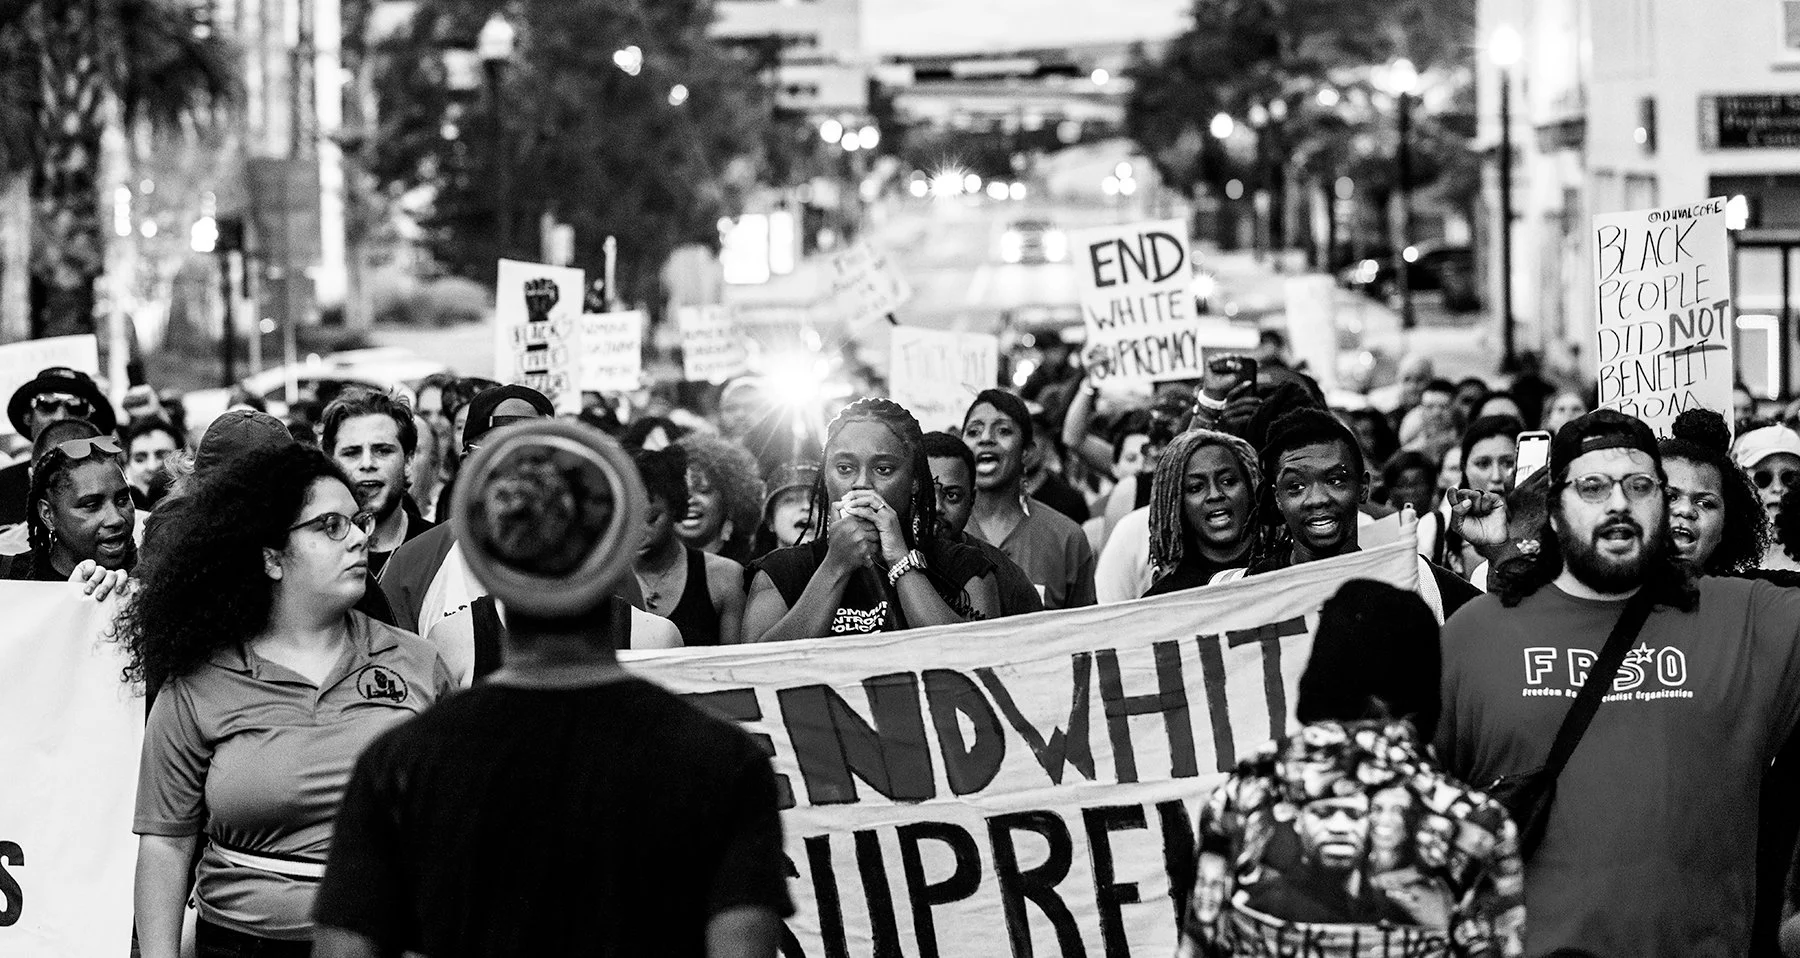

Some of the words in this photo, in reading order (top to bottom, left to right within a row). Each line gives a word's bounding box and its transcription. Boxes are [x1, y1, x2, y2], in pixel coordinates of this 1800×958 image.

[1089, 231, 1184, 288] END
[1597, 219, 1698, 281] BLACK
[1088, 290, 1185, 330] WHITE
[1598, 264, 1710, 324] PEOPLE
[1597, 321, 1664, 363] DID
[1669, 299, 1729, 348] NOT
[1599, 339, 1710, 403] BENEFIT
[1603, 390, 1702, 419] ROM
[972, 615, 1309, 786] WHIT
[1522, 687, 1562, 697] Freedom
[1601, 692, 1633, 703] cialist
[1635, 688, 1694, 701] Organization
